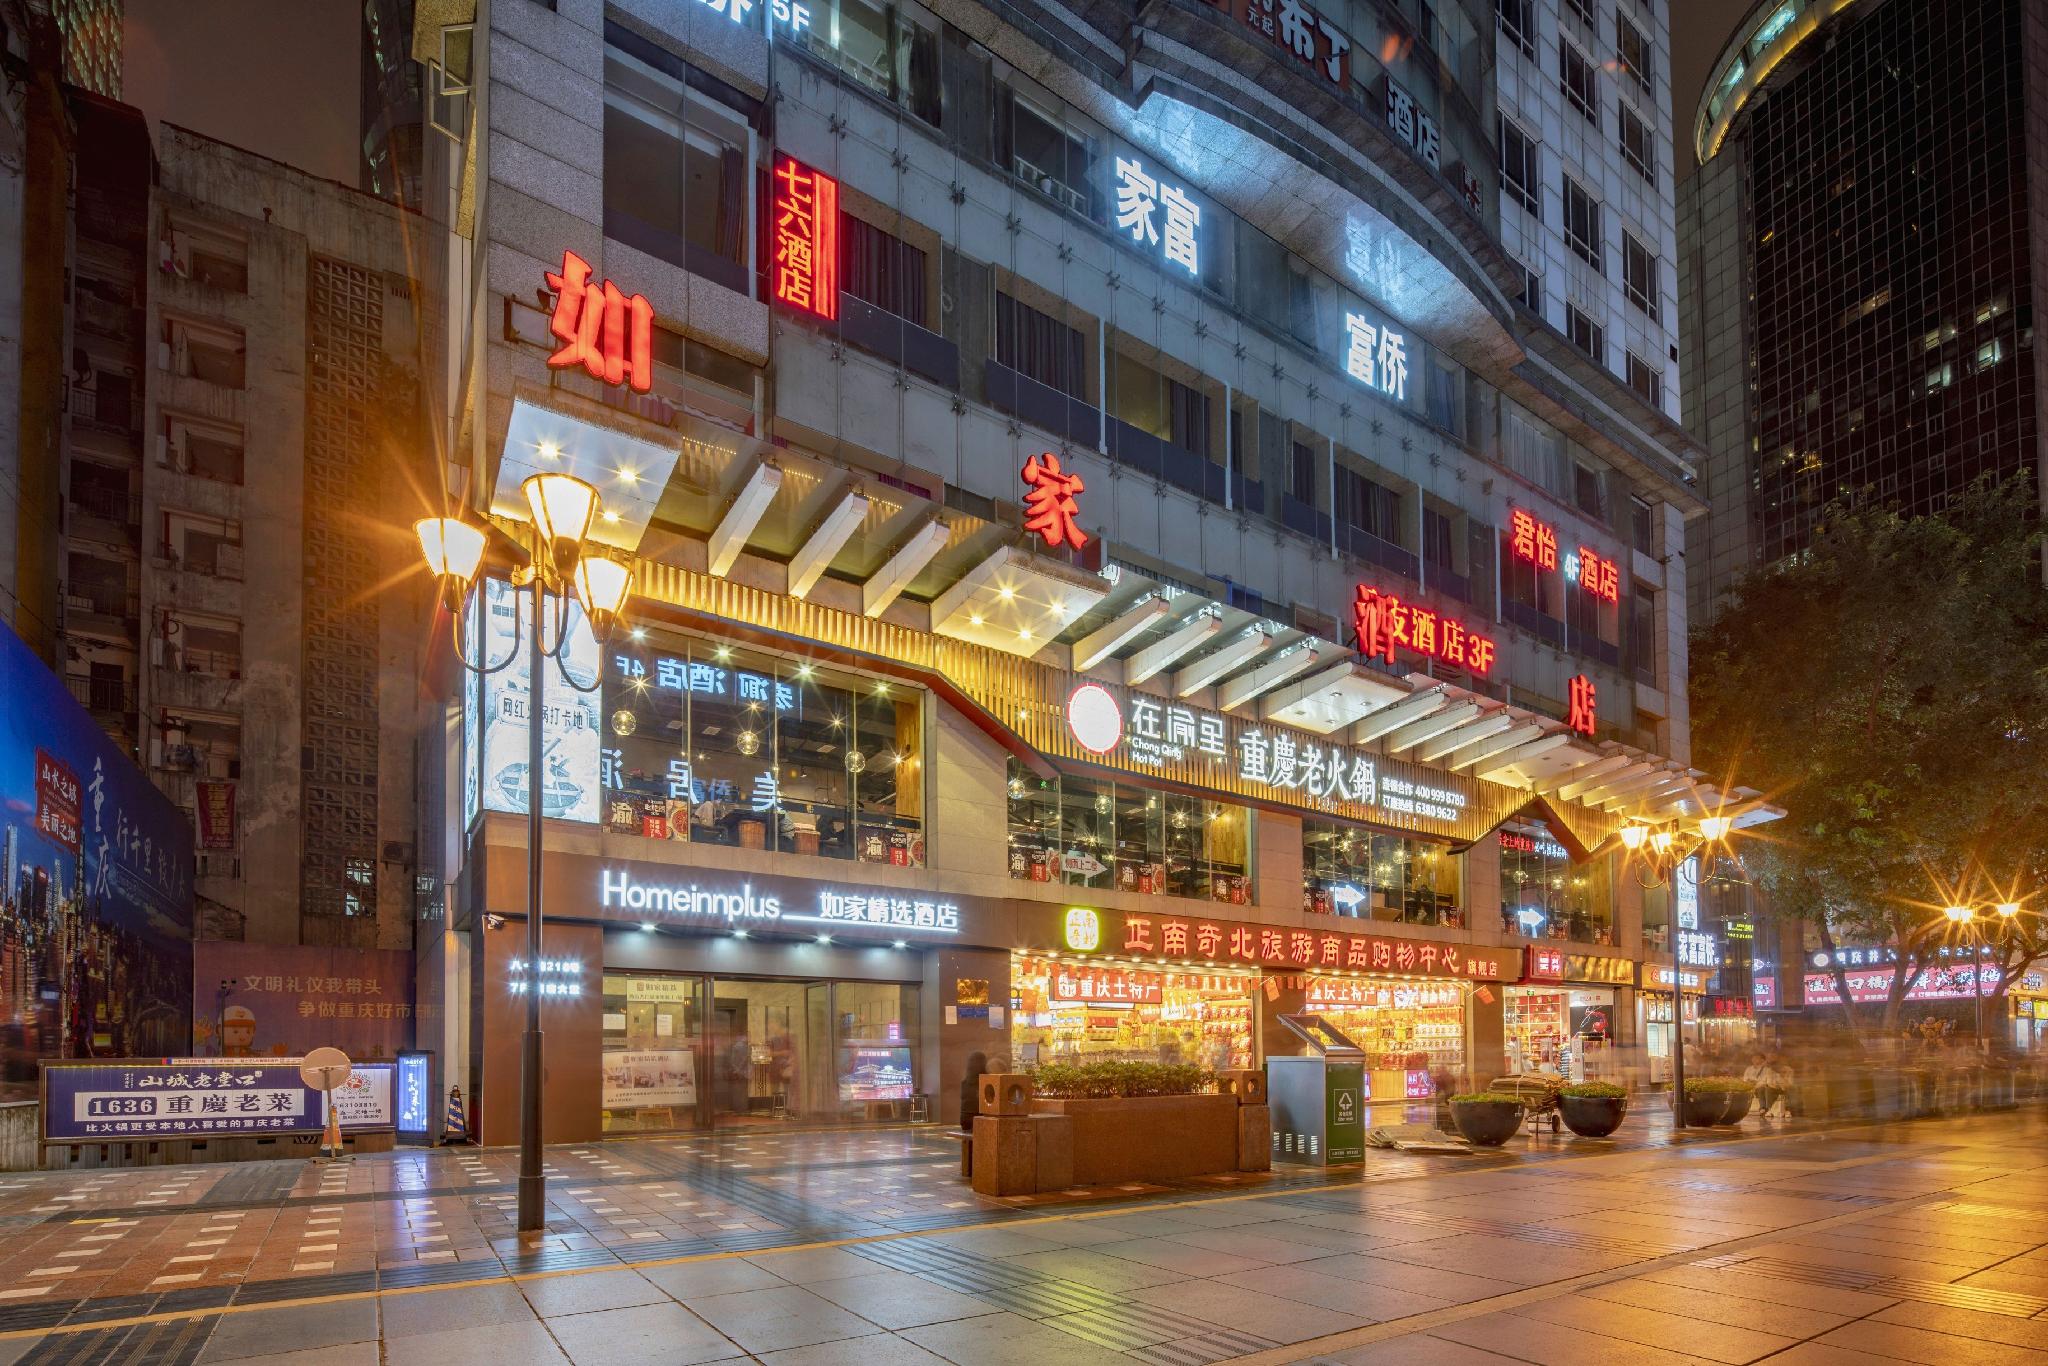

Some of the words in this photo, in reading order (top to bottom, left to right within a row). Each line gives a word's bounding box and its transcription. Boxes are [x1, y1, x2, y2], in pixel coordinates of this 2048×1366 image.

[772, 0, 810, 31] 5F
[1278, 0, 1350, 82] 布丁
[1388, 81, 1440, 171] 酒店
[776, 159, 813, 309] 七六酒店
[1115, 155, 1200, 276] 家富
[1345, 311, 1408, 401] 富侨
[545, 250, 654, 393] 如
[1023, 453, 1085, 549] 家
[1568, 674, 1596, 737] 店
[1513, 509, 1557, 571] 君怡
[1579, 547, 1618, 602] 酒店
[1132, 737, 1160, 755] Chong
[1161, 744, 1182, 760] Qing
[1132, 750, 1148, 764] Hot
[1148, 753, 1162, 767] Pot
[42, 762, 77, 807] 山水之城
[1415, 785, 1430, 799] 400
[1431, 788, 1446, 802] 999
[1446, 791, 1465, 807] 8780
[40, 803, 77, 844] 美丽之地
[1415, 801, 1436, 817] 6380
[1436, 805, 1457, 821] 9622
[602, 869, 780, 922] Homeinnplus
[1123, 917, 1461, 974] 正南奇北旅游商品购物中心
[1466, 959, 1498, 978] 旗舰店
[243, 974, 383, 995] 文明礼仪我带头
[92, 1098, 153, 1115] 1636
